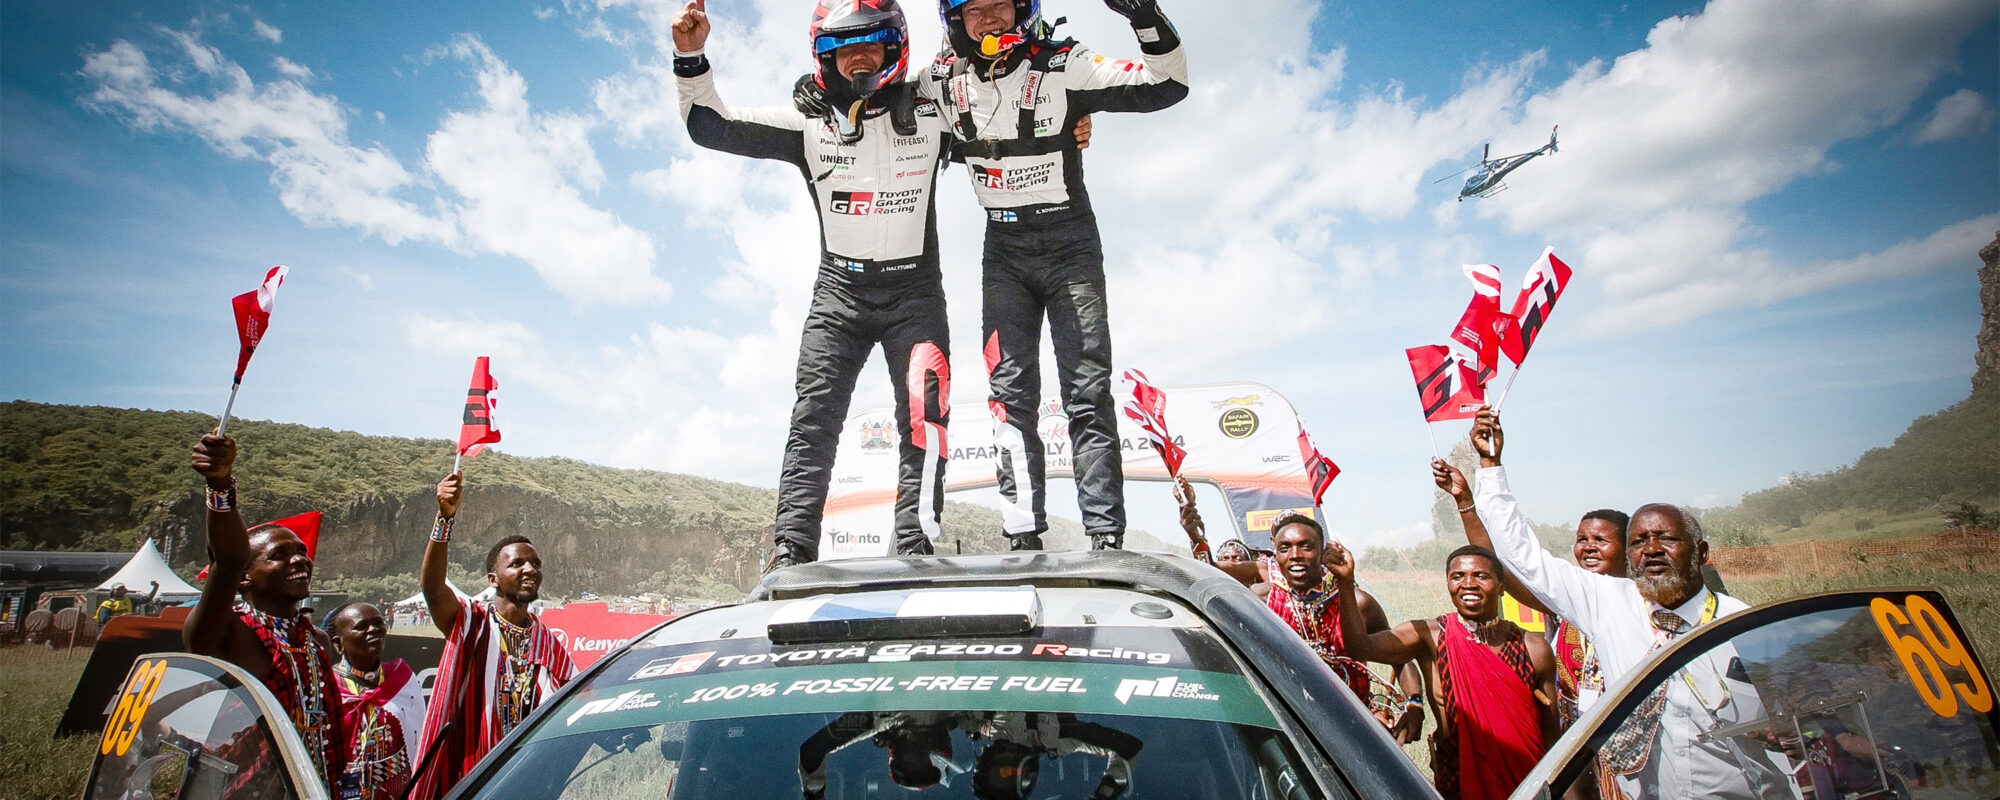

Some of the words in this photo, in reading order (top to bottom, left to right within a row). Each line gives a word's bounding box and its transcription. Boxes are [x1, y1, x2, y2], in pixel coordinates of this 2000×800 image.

[1047, 54, 1067, 69] OMP
[1024, 74, 1037, 105] SIMPSON
[916, 103, 936, 115] OMP
[820, 154, 856, 166] UNIBET
[1006, 161, 1055, 177] TOYOTA
[1006, 169, 1050, 185] GAZOO
[1006, 176, 1049, 191] Racing
[879, 188, 923, 199] TOYOTA
[830, 198, 872, 215] GR
[875, 197, 918, 207] GAZOO
[873, 205, 915, 215] Racing
[716, 649, 867, 668] TOYOTA
[876, 644, 1023, 656] GAZOO
[1032, 643, 1171, 665] Racing
[1870, 594, 1993, 718] 69
[682, 682, 780, 704] 100%
[782, 676, 999, 696] FOSSIL-FREE
[1001, 676, 1088, 693] FUEL
[1177, 682, 1206, 690] FUEL
[1172, 692, 1220, 701] CHANGE
[102, 659, 168, 756] 69
